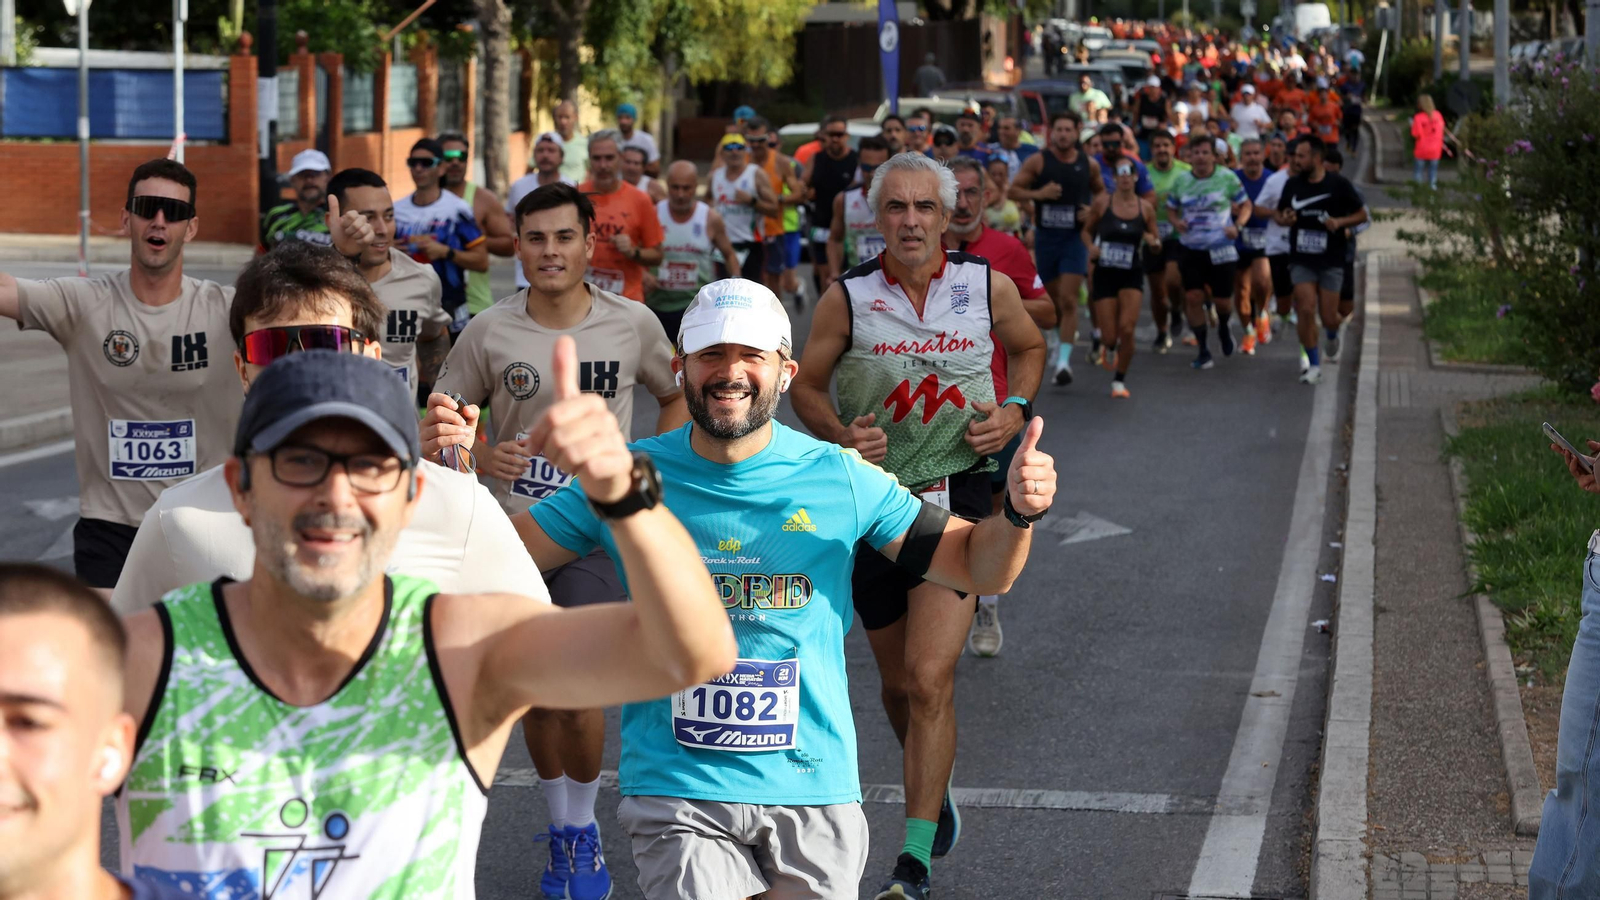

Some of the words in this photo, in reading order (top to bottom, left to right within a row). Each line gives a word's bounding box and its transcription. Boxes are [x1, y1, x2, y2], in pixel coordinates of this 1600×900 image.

[716, 294, 753, 304] ATHENS
[387, 310, 418, 335] IX
[172, 332, 208, 364] IX
[872, 330, 975, 355] maratón
[171, 361, 208, 372] CIA
[903, 360, 948, 369] JEREZ
[580, 361, 620, 391] IX
[124, 441, 181, 461] 1063
[529, 458, 572, 484] 109
[782, 523, 817, 532] adidas
[718, 537, 741, 554] edp
[711, 573, 814, 610] DRID
[730, 614, 766, 622] THON
[693, 687, 778, 721] 1082
